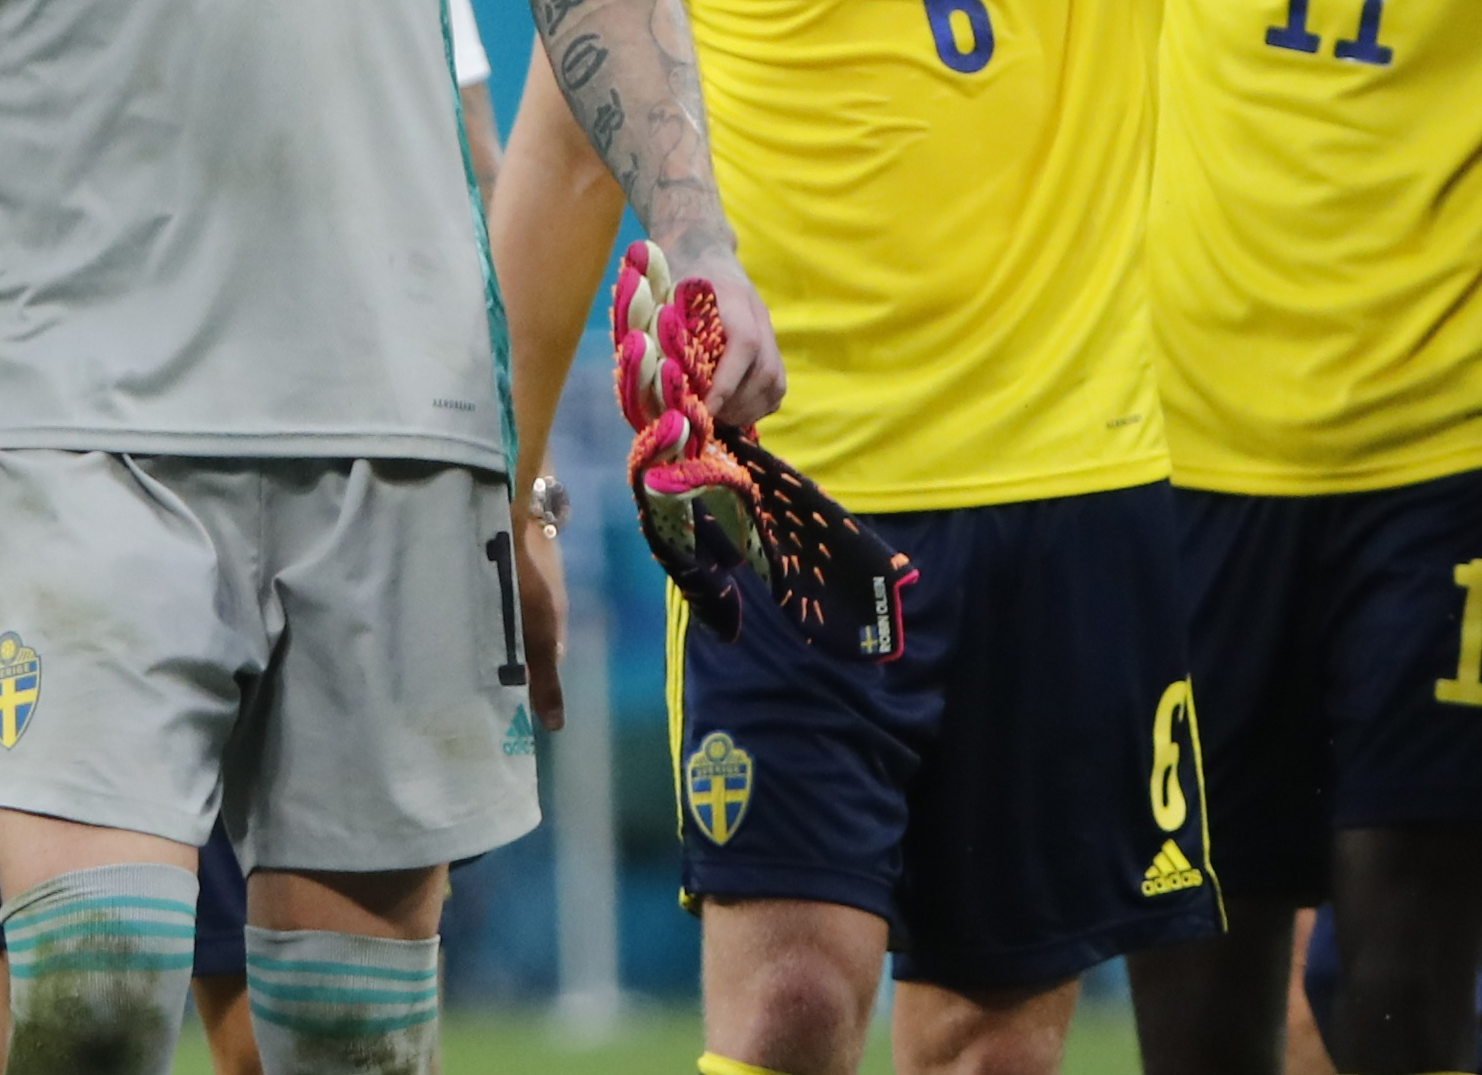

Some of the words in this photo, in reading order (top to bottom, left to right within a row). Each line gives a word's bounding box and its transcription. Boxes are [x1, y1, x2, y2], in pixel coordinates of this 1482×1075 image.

[486, 531, 527, 686] 1
[1150, 680, 1188, 832] 6
[1141, 868, 1203, 897] adidas
